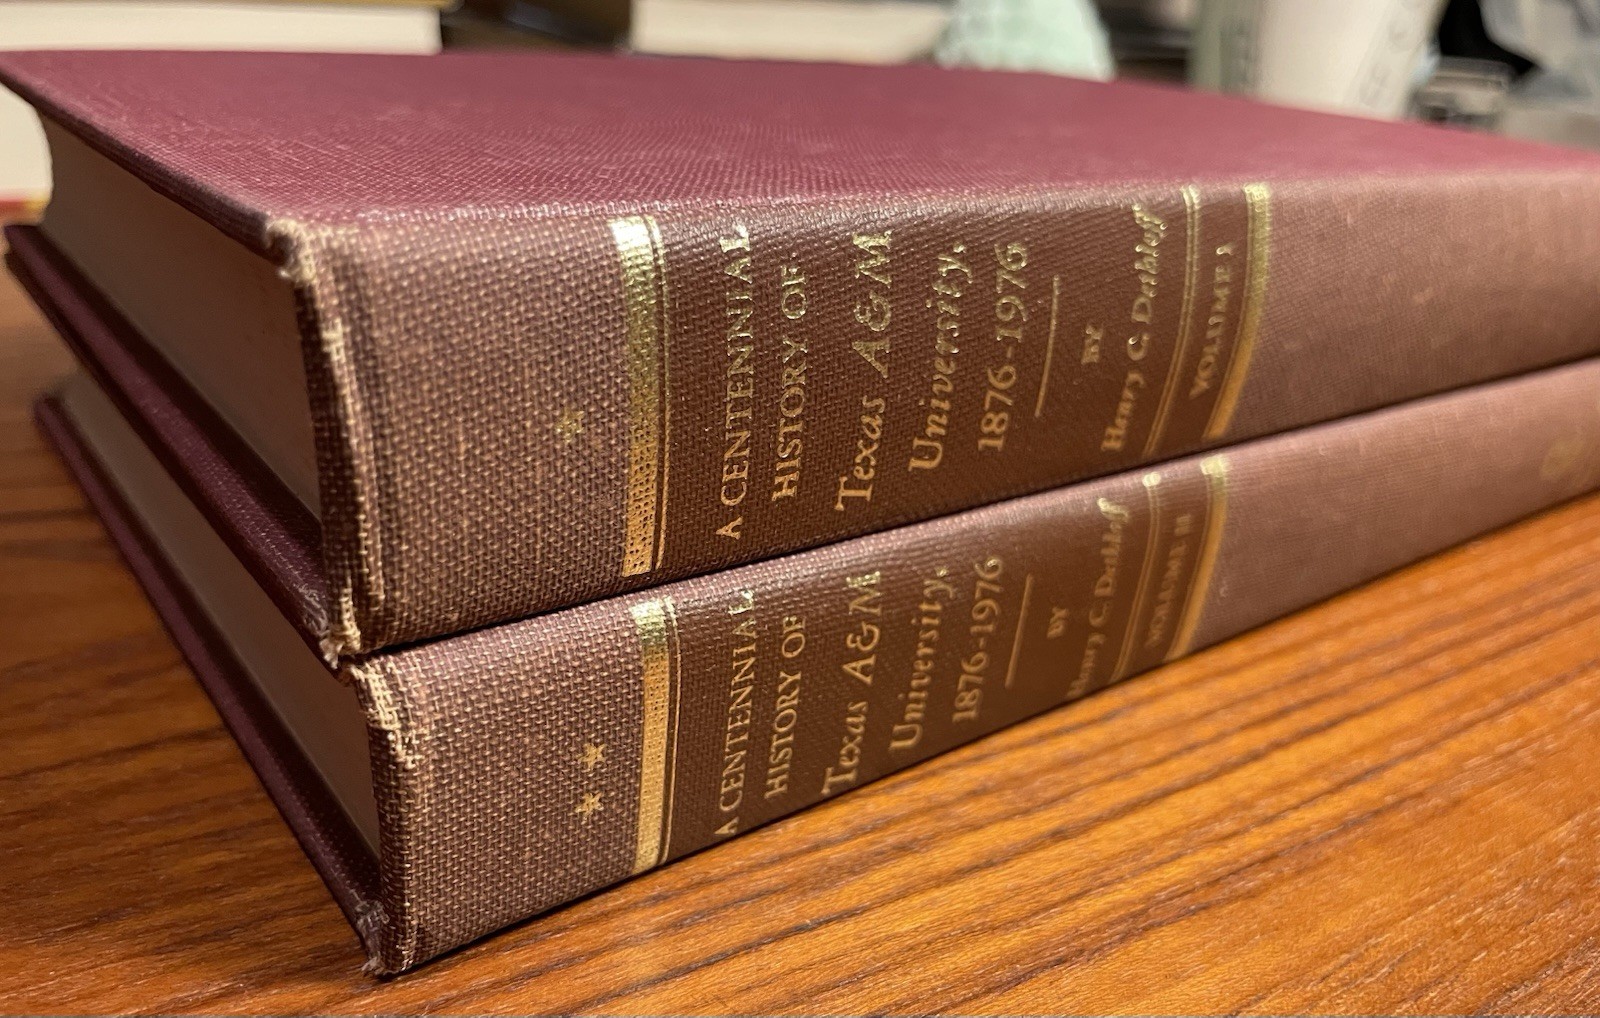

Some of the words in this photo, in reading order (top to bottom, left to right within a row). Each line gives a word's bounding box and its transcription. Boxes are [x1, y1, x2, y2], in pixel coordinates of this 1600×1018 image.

[780, 262, 807, 321] OF
[851, 229, 893, 379] A&M
[977, 242, 1029, 452] 1876-1976
[1081, 322, 1102, 365] BY
[1188, 264, 1231, 398] VOLUME
[719, 223, 753, 507] CENTENNIAL
[771, 336, 808, 502] HISTORY
[833, 395, 886, 512] Texas
[715, 516, 743, 540] A
[780, 614, 807, 659] OF
[842, 570, 881, 686] A&M
[952, 556, 1003, 724] 1876-1976
[718, 588, 756, 812] CENTENNIAL
[763, 670, 802, 800] HISTORY
[819, 700, 869, 797] Texas
[714, 816, 740, 837] A
